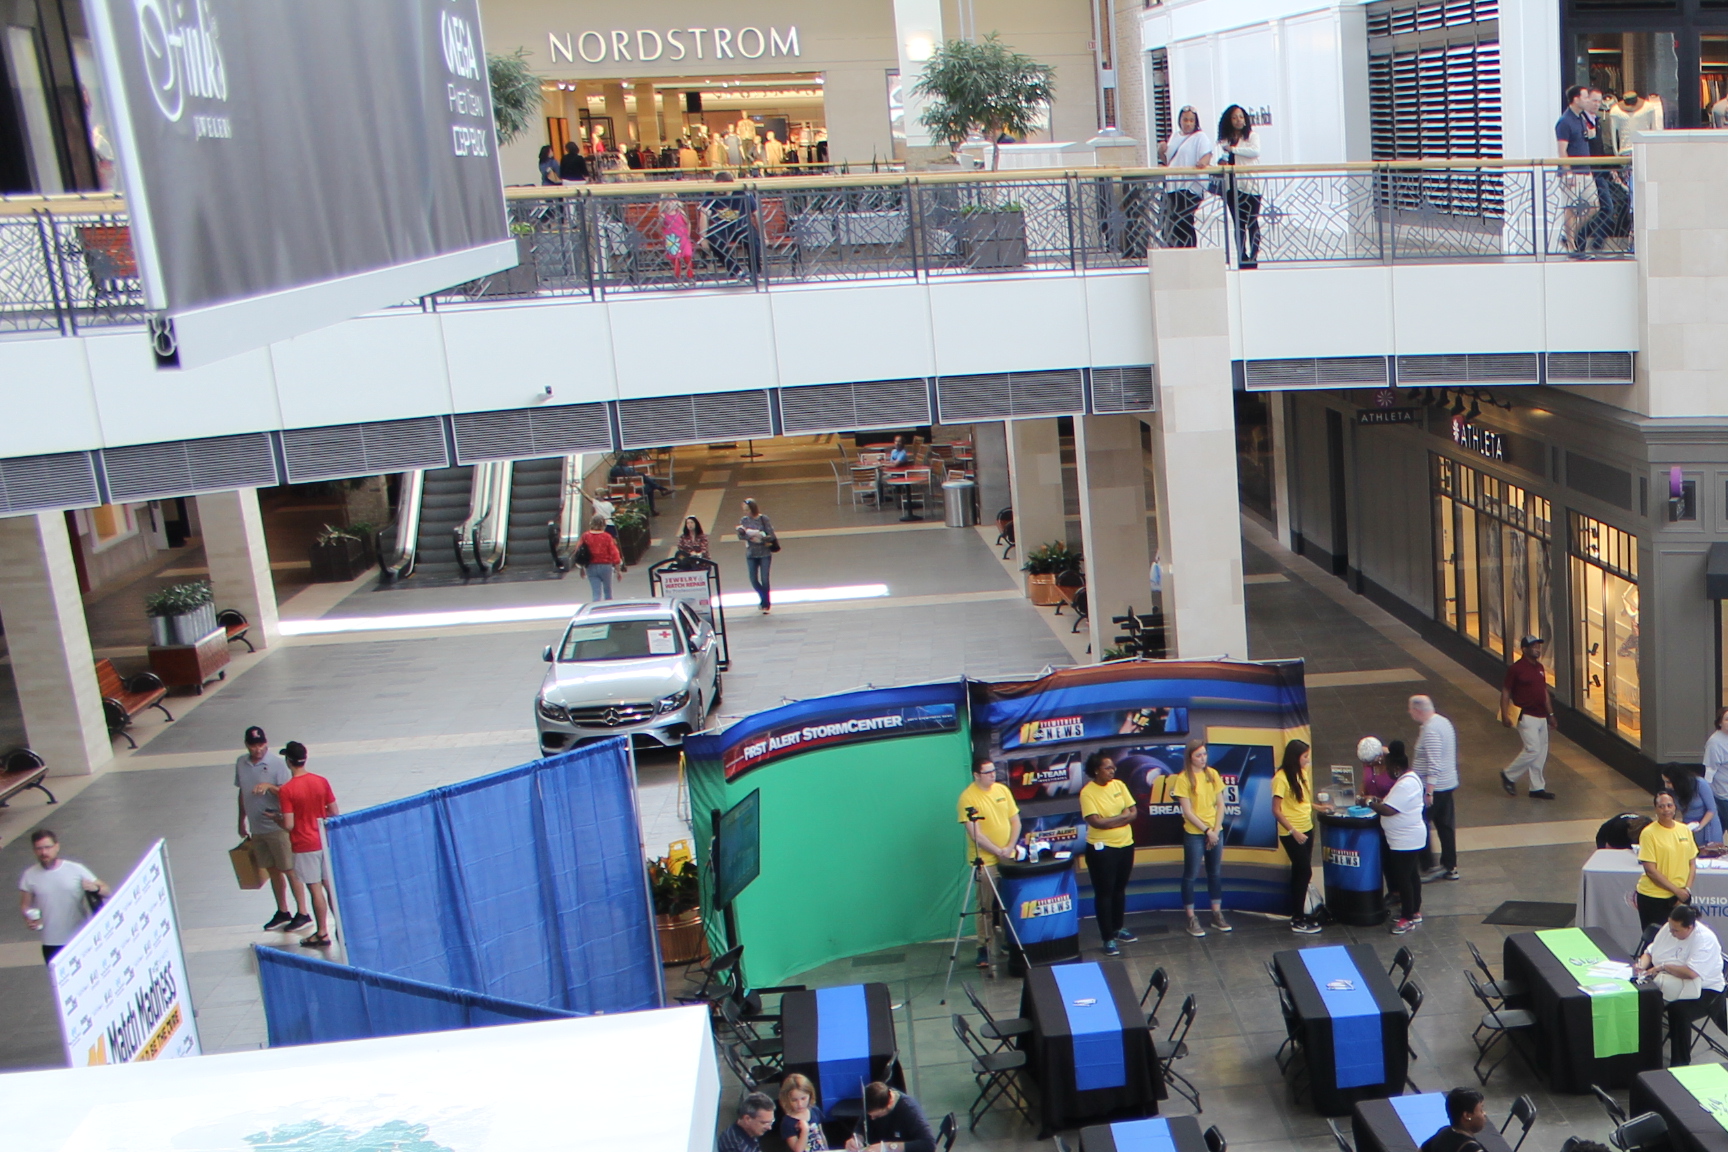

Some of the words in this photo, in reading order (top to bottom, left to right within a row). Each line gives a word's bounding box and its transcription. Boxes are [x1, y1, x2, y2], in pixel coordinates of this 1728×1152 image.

[548, 26, 800, 63] NORDSTROM
[1361, 411, 1412, 423] ATHLETA
[1461, 424, 1503, 461] ATHLETA
[665, 576, 697, 584] JEWELRY
[1040, 717, 1082, 729] EYEWITNESS
[743, 741, 768, 761] FIRST
[768, 732, 802, 752] ALERT
[801, 715, 903, 741] STORMCENTER
[1046, 725, 1082, 740] NEWS
[1036, 769, 1068, 780] I-TEAM
[1149, 804, 1183, 816] BREA
[1334, 856, 1359, 867] NEWS
[1043, 901, 1071, 916] NEWS
[108, 1001, 141, 1065] Match
[135, 961, 178, 1041] Madness
